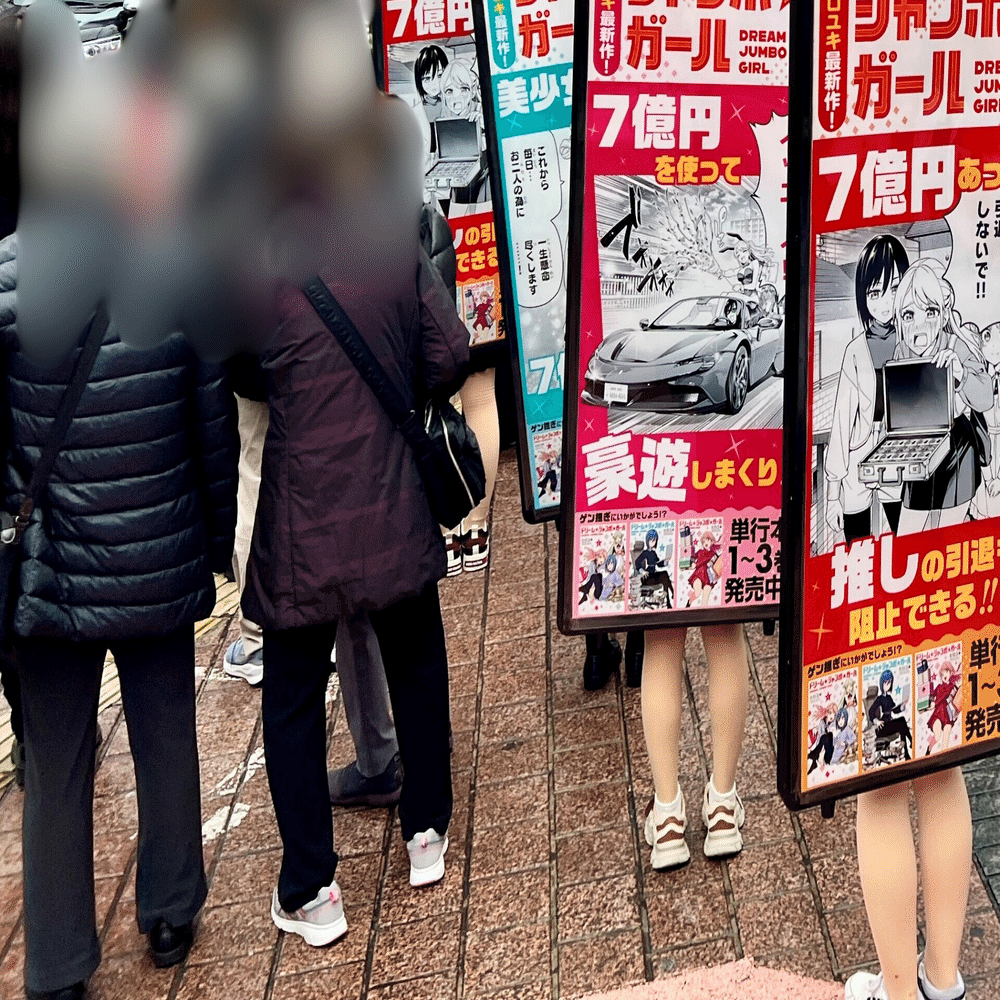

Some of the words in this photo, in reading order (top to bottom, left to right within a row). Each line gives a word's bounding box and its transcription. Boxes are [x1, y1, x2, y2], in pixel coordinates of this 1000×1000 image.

[627, 14, 731, 73] ガール
[739, 29, 786, 43] DREAM
[739, 46, 787, 59] JUMBO
[739, 61, 770, 75] GIRL
[853, 49, 965, 121] ガール
[592, 93, 722, 150] 7億円
[537, 146, 549, 191] これから
[655, 154, 742, 184] を使って
[975, 200, 990, 299] しないで!!
